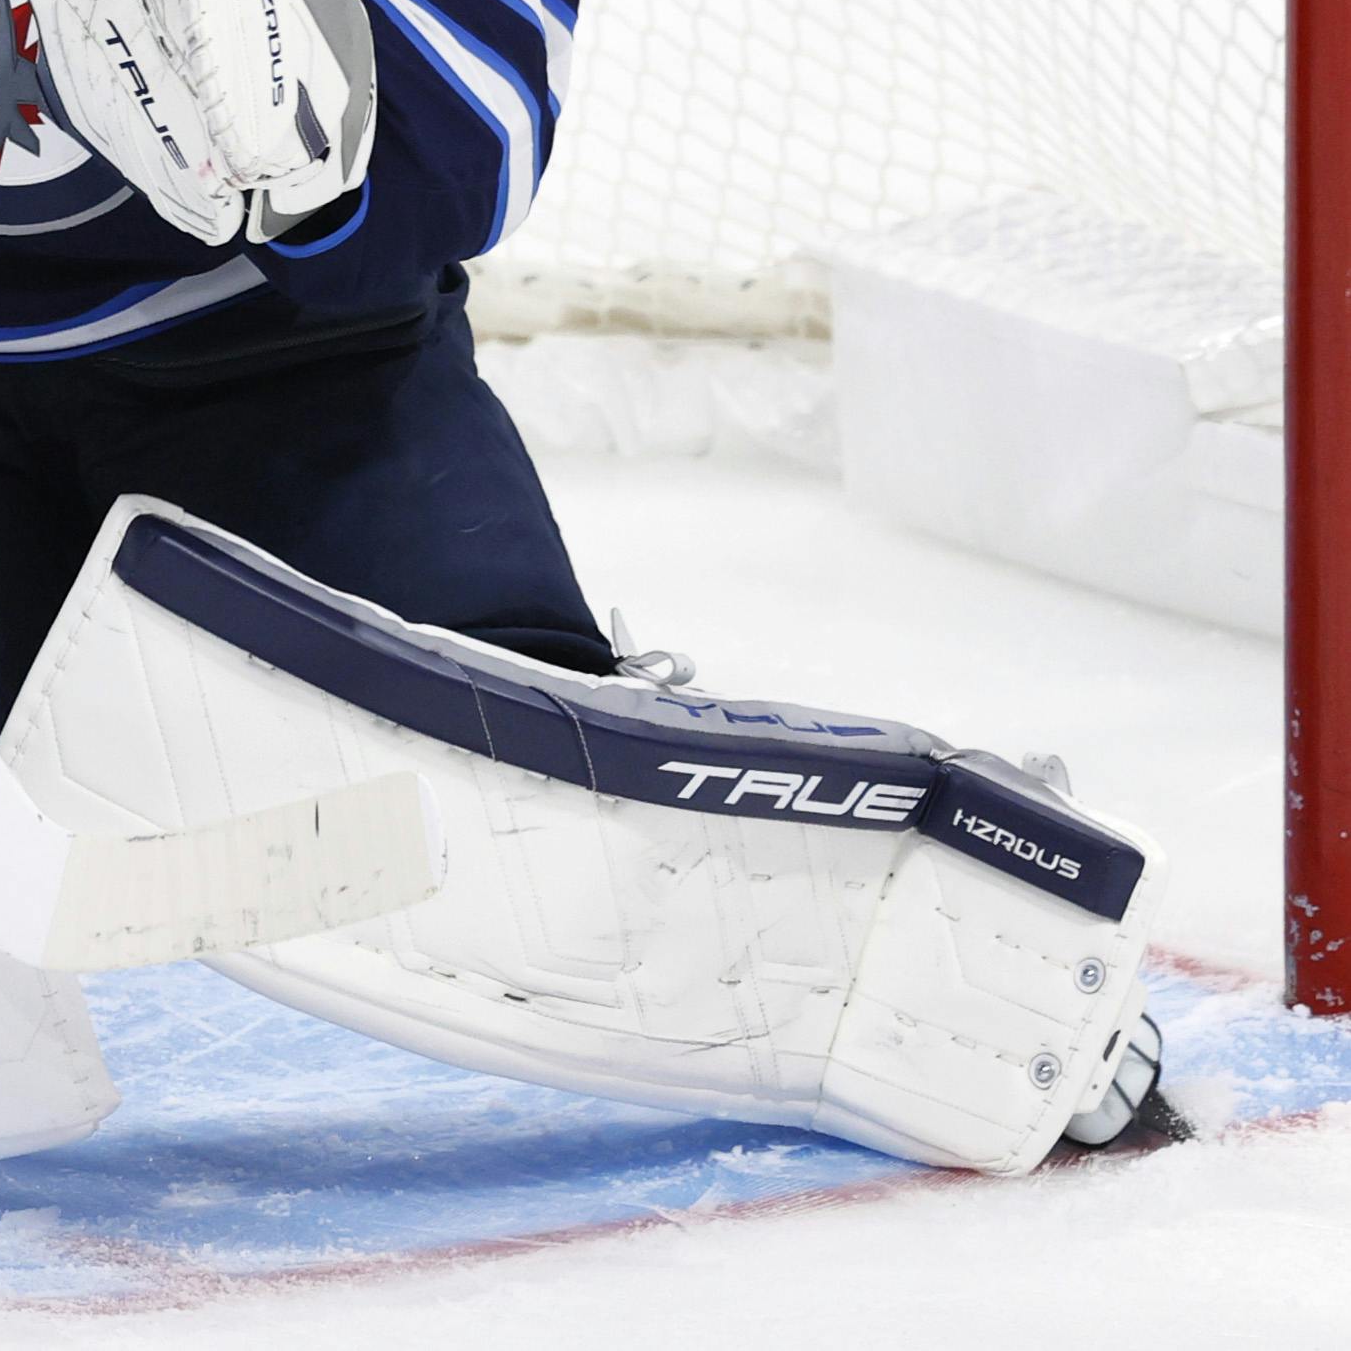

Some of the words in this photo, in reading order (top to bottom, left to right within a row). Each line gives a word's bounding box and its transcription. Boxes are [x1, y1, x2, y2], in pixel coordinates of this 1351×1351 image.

[106, 18, 190, 171] TRUE
[657, 759, 927, 823] TRUE
[951, 807, 1083, 882] HZRDUS
